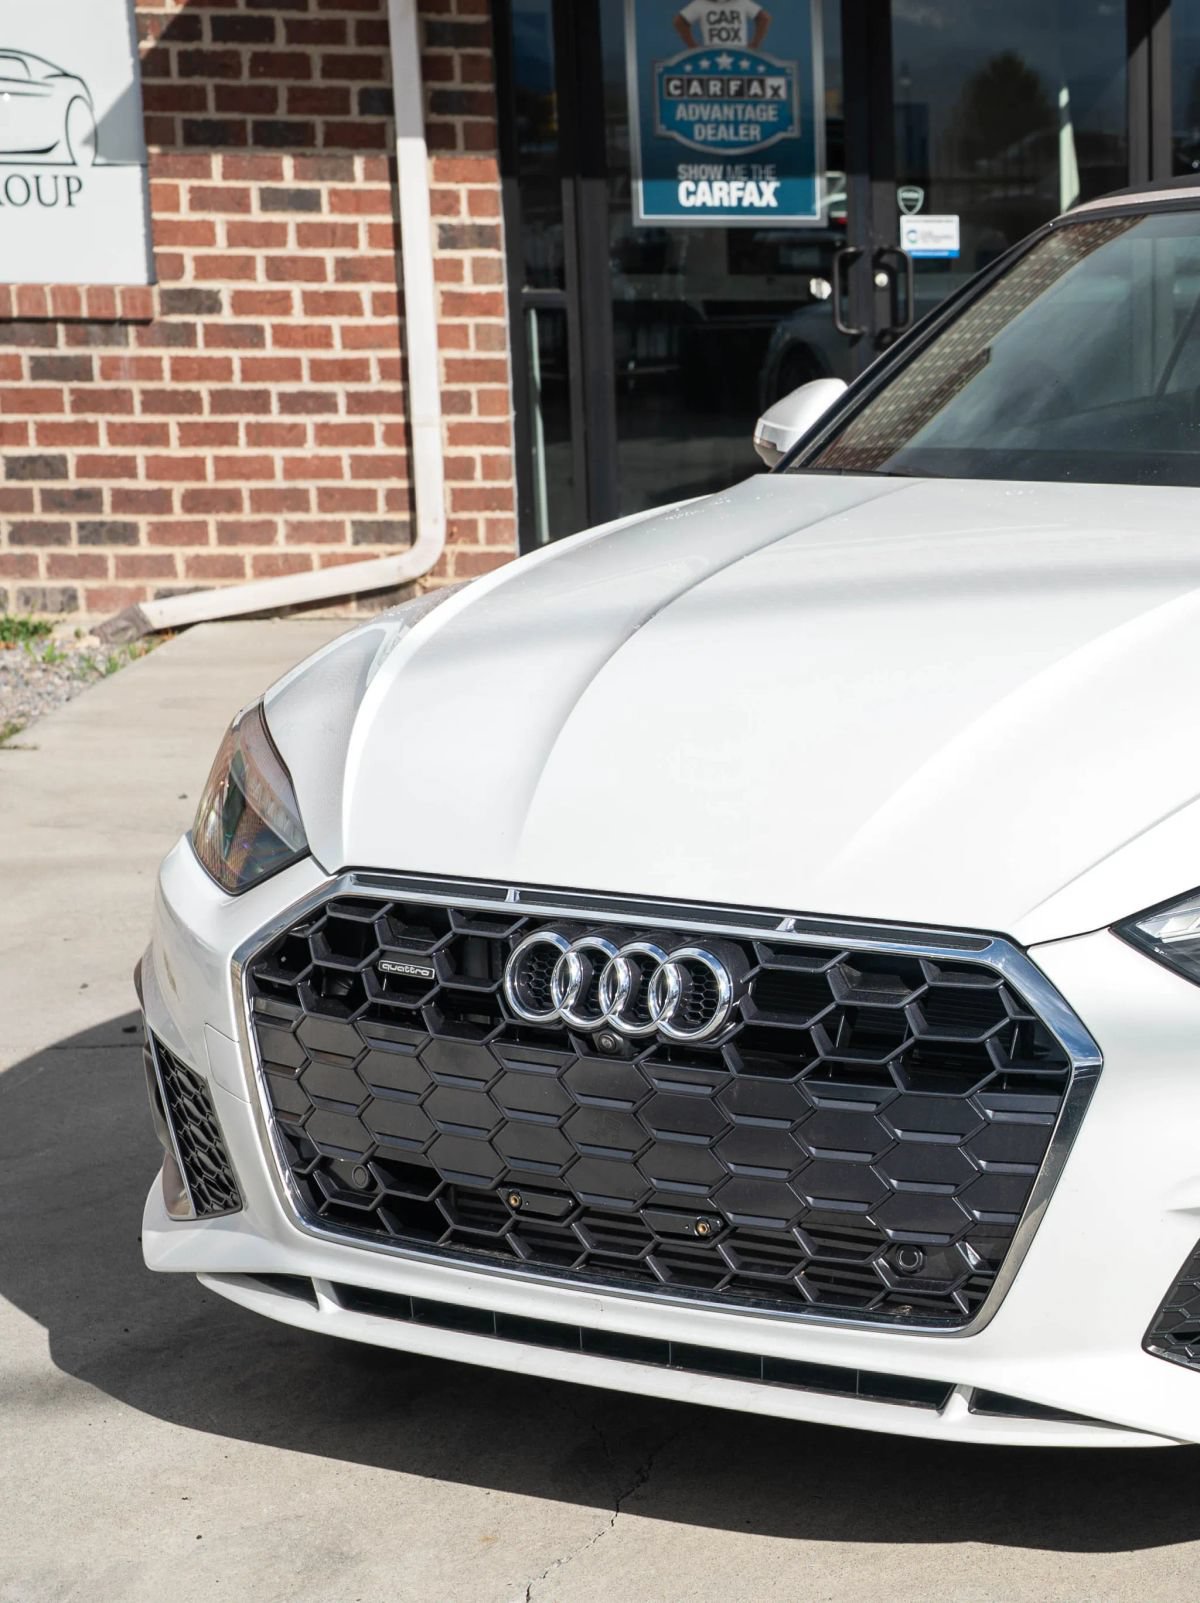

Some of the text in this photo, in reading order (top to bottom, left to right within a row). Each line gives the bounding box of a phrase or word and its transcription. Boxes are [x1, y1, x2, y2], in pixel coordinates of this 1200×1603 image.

[706, 10, 742, 25] CAR
[708, 27, 742, 43] FOX
[668, 78, 783, 98] CARFAX
[675, 103, 779, 122] ADVANTAGE
[693, 124, 762, 142] DEALER
[677, 163, 723, 180] SHOW
[0, 173, 83, 208] OUP
[677, 181, 779, 208] CARFAX
[381, 963, 430, 977] quattro
